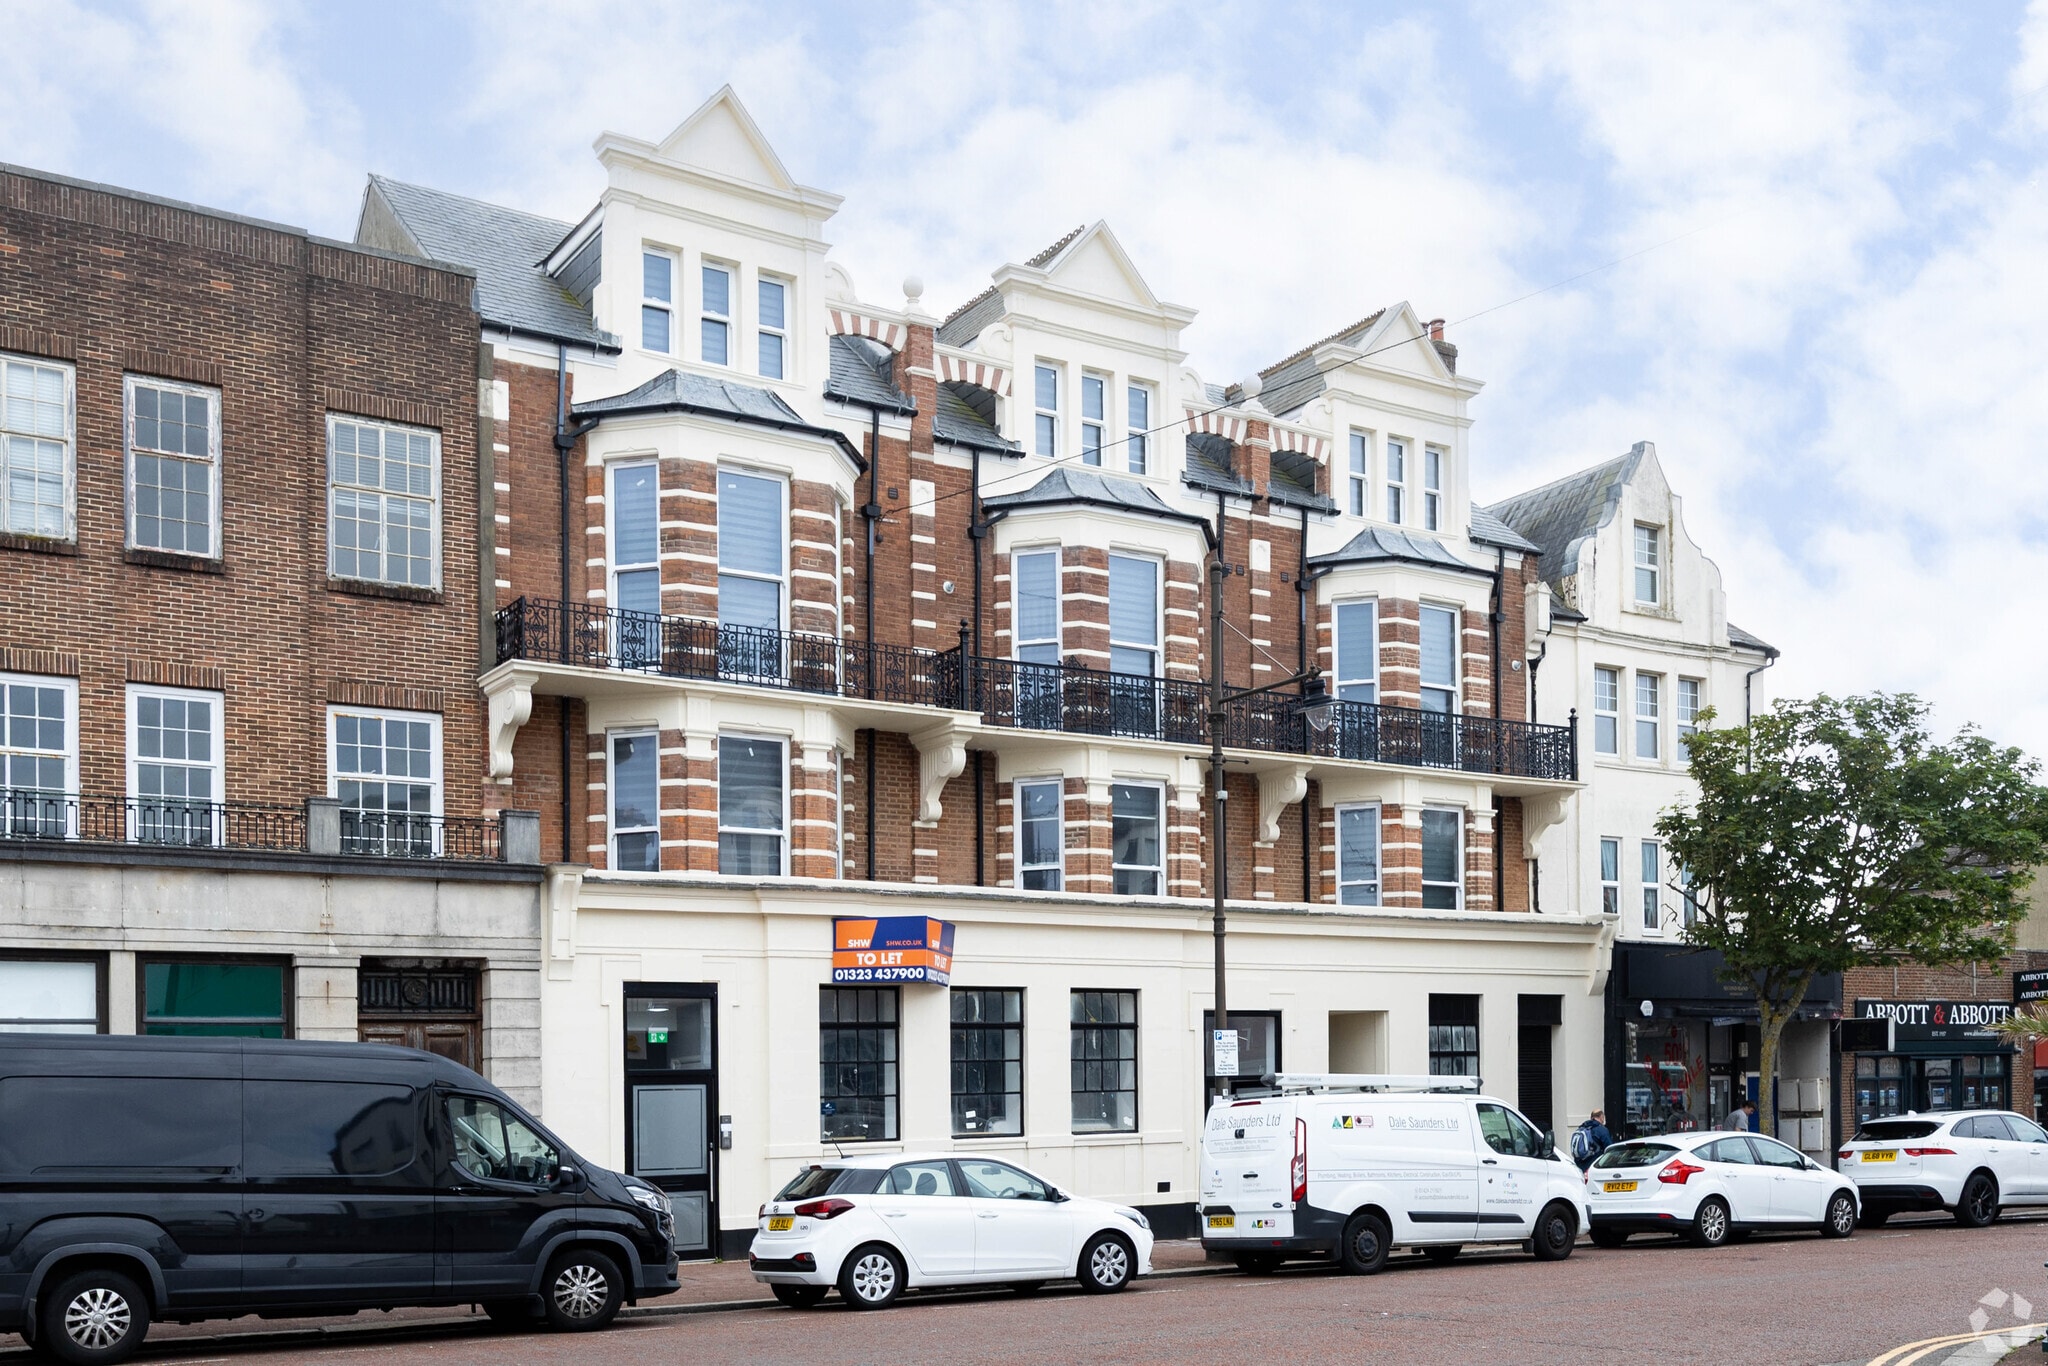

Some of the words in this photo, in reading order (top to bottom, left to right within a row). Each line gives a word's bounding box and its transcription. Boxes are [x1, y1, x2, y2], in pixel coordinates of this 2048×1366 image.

[848, 939, 871, 948] SHW
[856, 953, 876, 965] TO
[881, 952, 903, 965] LET
[835, 968, 872, 981] 01323
[874, 968, 924, 979] 437900
[1865, 1003, 1930, 1025] ABBOTT
[1933, 1004, 1945, 1025] &
[1949, 1004, 2010, 1025] ABBOTT
[1211, 1118, 1226, 1131] Dale
[1227, 1114, 1264, 1129] Saunders
[1266, 1113, 1282, 1127] Ltd
[1388, 1115, 1407, 1128] Dale
[1409, 1116, 1445, 1129] Saunders
[1446, 1118, 1459, 1129] Ltd
